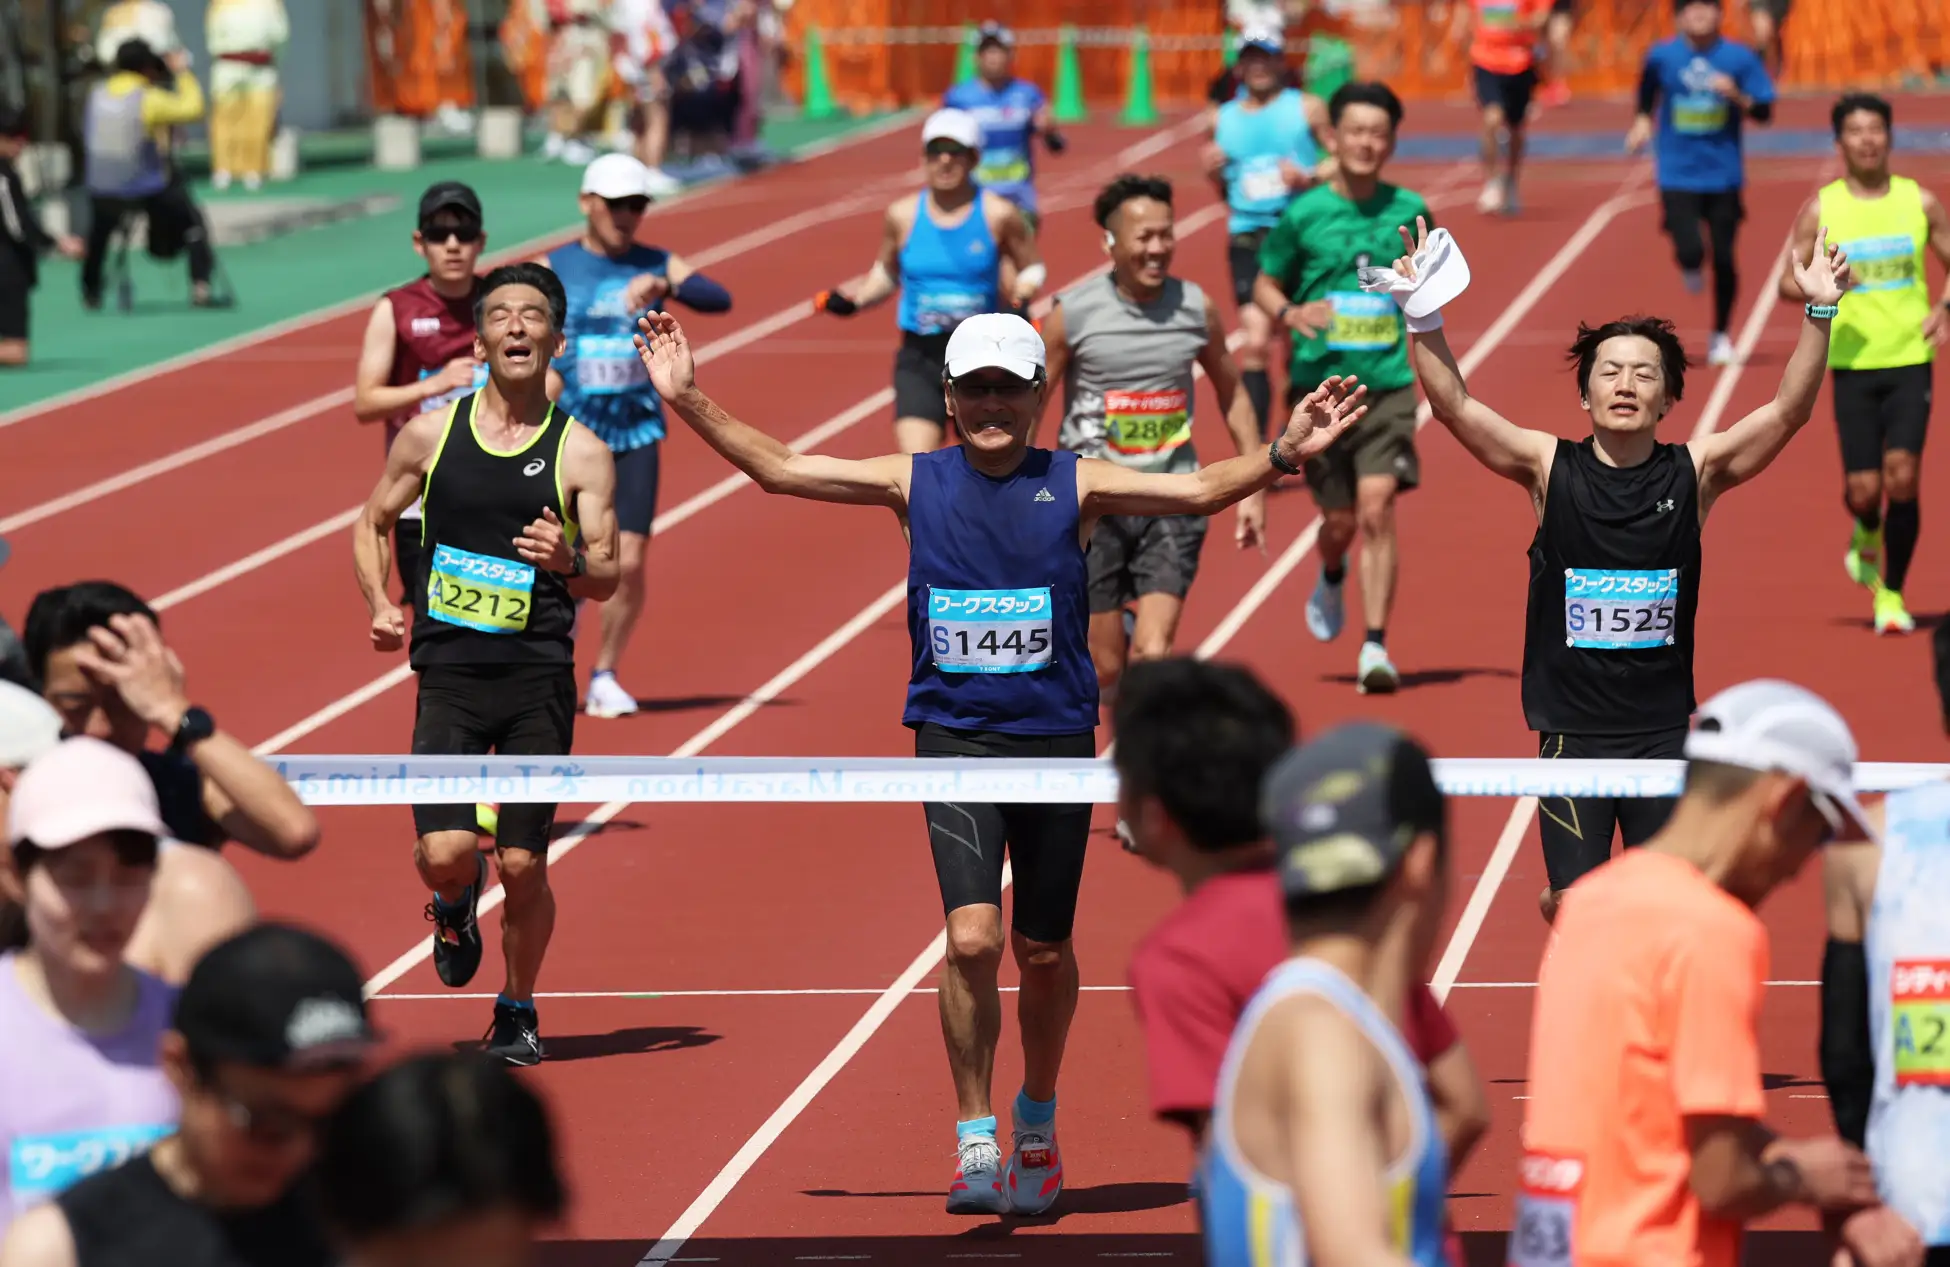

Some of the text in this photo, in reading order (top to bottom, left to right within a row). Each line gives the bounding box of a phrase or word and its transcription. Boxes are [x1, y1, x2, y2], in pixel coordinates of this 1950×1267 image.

[438, 550, 530, 584] ワークスタッフ
[429, 577, 526, 622] A2212
[1571, 575, 1672, 594] ワークスタッフ
[934, 594, 1045, 615] ワークスタッフ
[1568, 603, 1674, 633] S1525
[933, 625, 1049, 656] S1445
